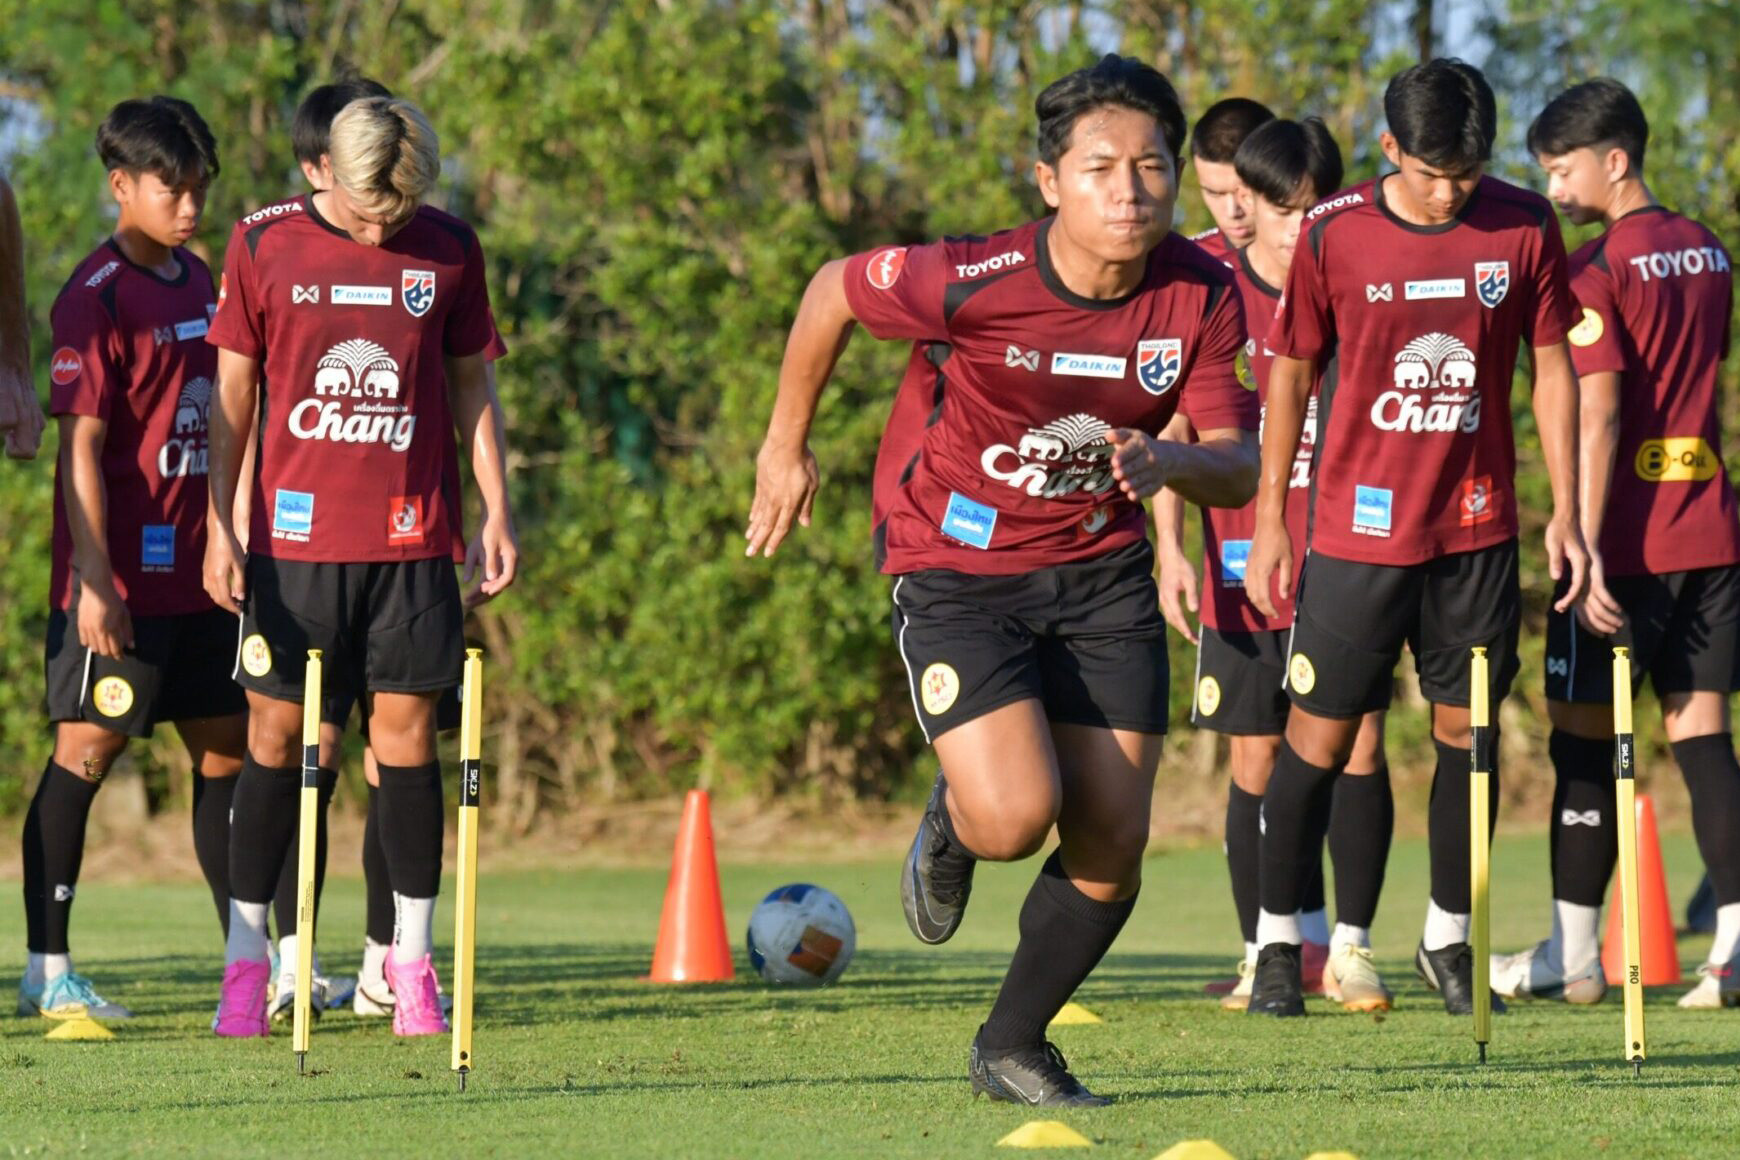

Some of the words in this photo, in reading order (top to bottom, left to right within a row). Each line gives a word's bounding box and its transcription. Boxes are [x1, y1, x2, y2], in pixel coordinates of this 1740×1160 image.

[242, 201, 303, 225] TOYOTA
[1306, 193, 1364, 220] TOYOTA
[85, 260, 120, 288] TOYOTA
[955, 250, 1025, 278] TOYOTA
[1630, 246, 1730, 282] TOYOTA
[344, 290, 389, 301] DAIKIN
[1419, 284, 1462, 295] DAIKIN
[1068, 359, 1122, 373] DAIKIN
[1370, 390, 1480, 433] Chang
[287, 398, 417, 453] Chang
[158, 438, 209, 480] Cha
[470, 769, 479, 792] SKLZ
[1629, 965, 1640, 985] PRO
